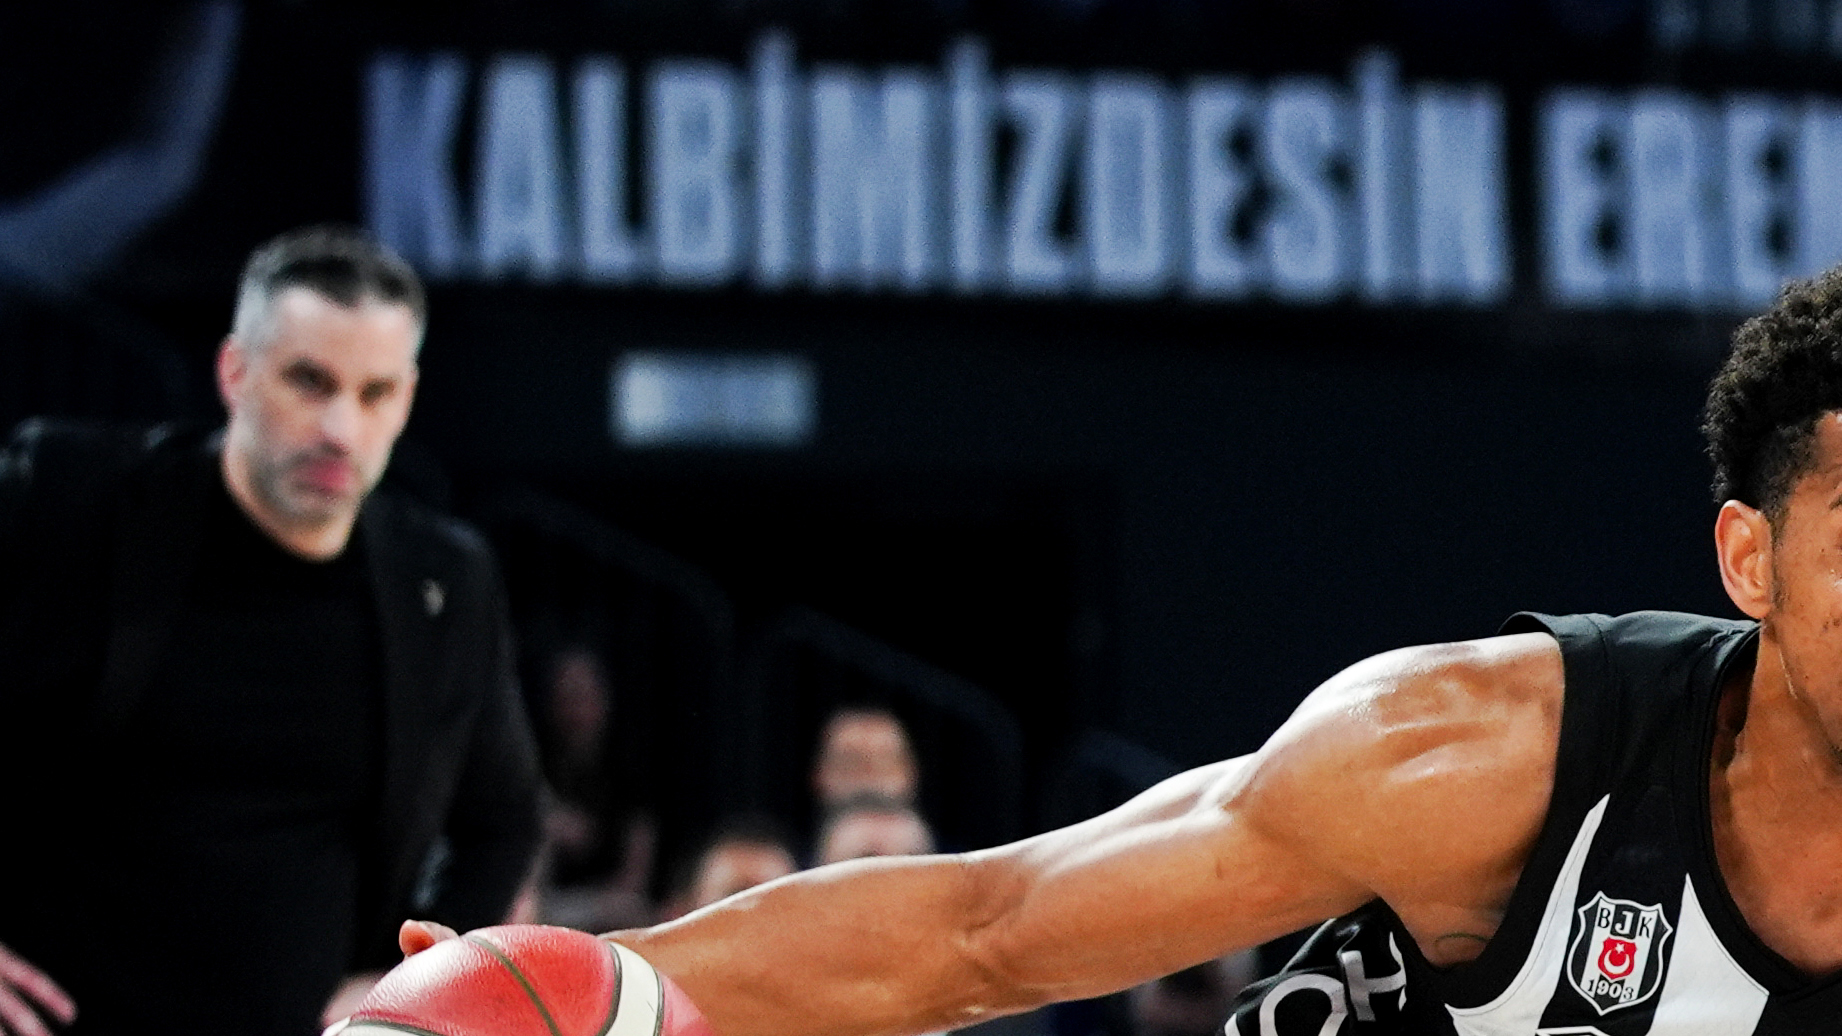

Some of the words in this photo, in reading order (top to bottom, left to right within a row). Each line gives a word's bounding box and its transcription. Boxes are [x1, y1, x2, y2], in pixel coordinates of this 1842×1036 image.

[366, 32, 1503, 302] KALBİMİZDESİN
[1597, 907, 1653, 939] BJK
[1588, 979, 1634, 1001] 1903
